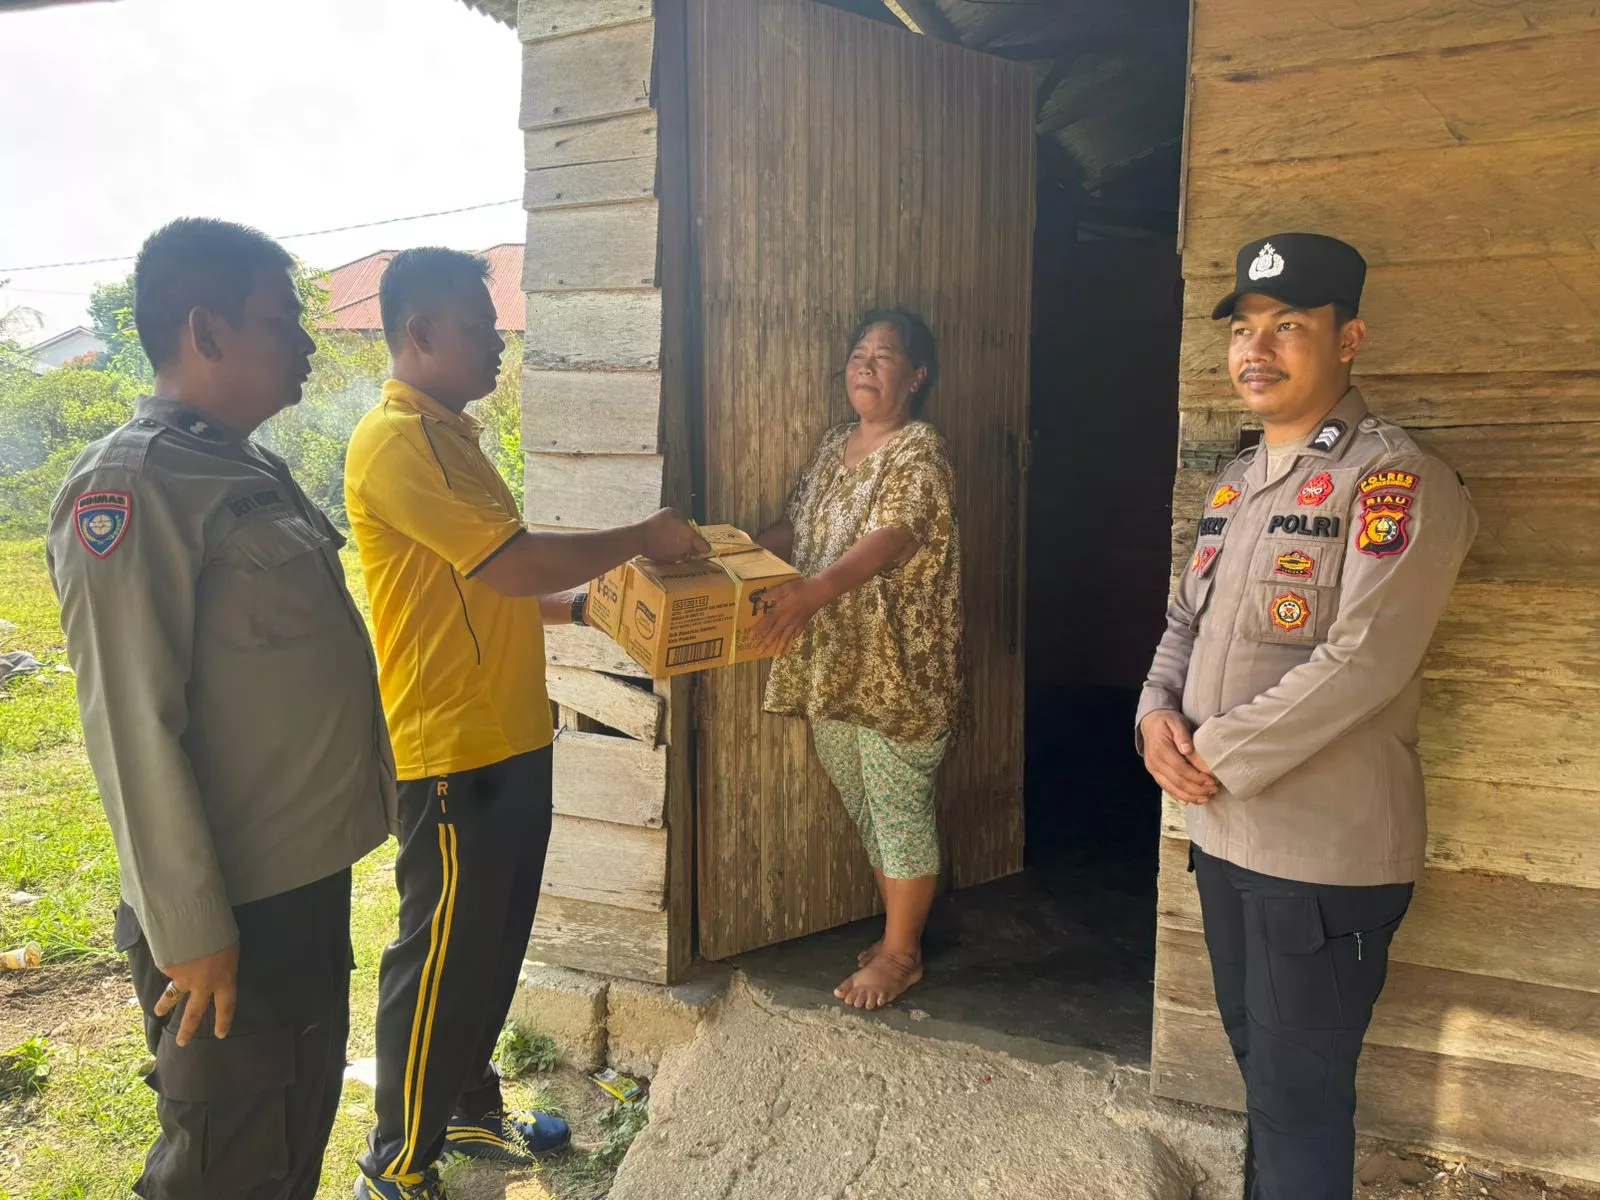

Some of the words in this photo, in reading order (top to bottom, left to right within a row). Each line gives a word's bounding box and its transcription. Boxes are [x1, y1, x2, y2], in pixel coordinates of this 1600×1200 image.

[1361, 472, 1414, 489] POLRES
[1366, 495, 1406, 505] RIAU
[1267, 514, 1341, 538] POLRI
[437, 775, 449, 814] RI
